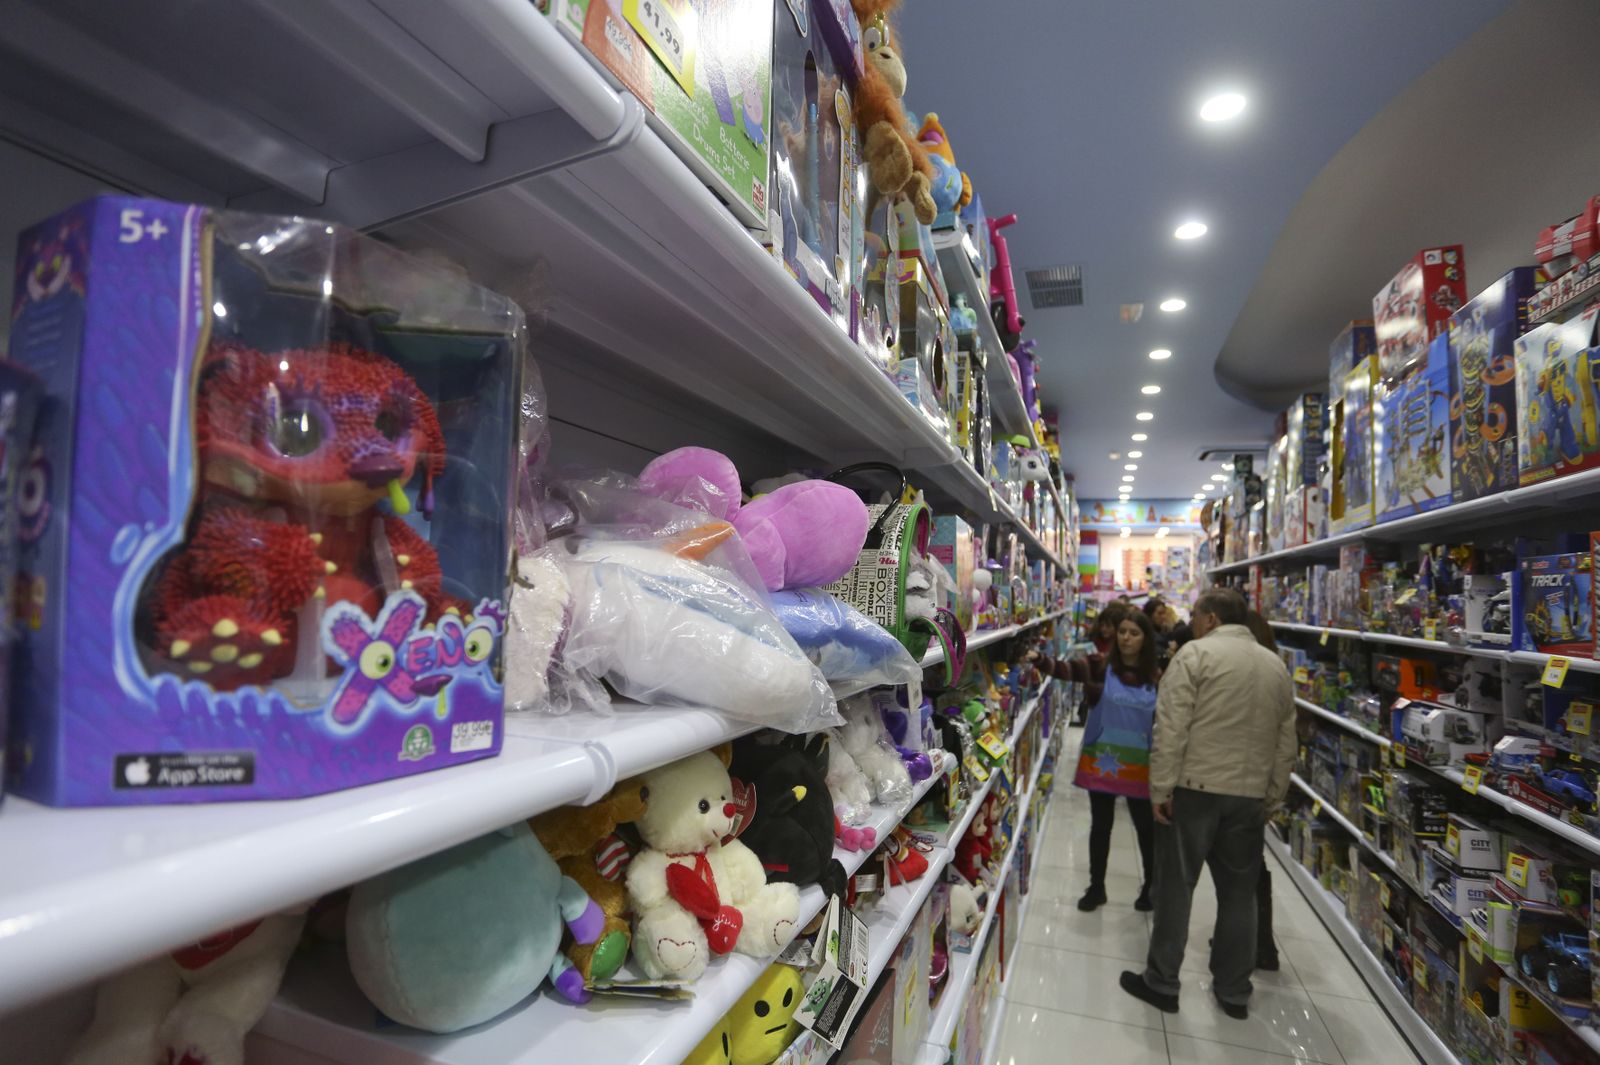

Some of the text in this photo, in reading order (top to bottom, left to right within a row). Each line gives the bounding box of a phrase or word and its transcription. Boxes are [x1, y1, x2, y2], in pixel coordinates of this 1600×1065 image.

[642, 1, 680, 55] 41.99
[693, 122, 720, 164] Drums
[120, 209, 169, 243] 5+
[857, 580, 868, 616] HUSKY
[875, 568, 887, 627] BOXER
[1531, 574, 1565, 587] TRACK
[867, 581, 875, 616] POODLE
[157, 764, 246, 787] App Store
[1470, 839, 1491, 848] CITY
